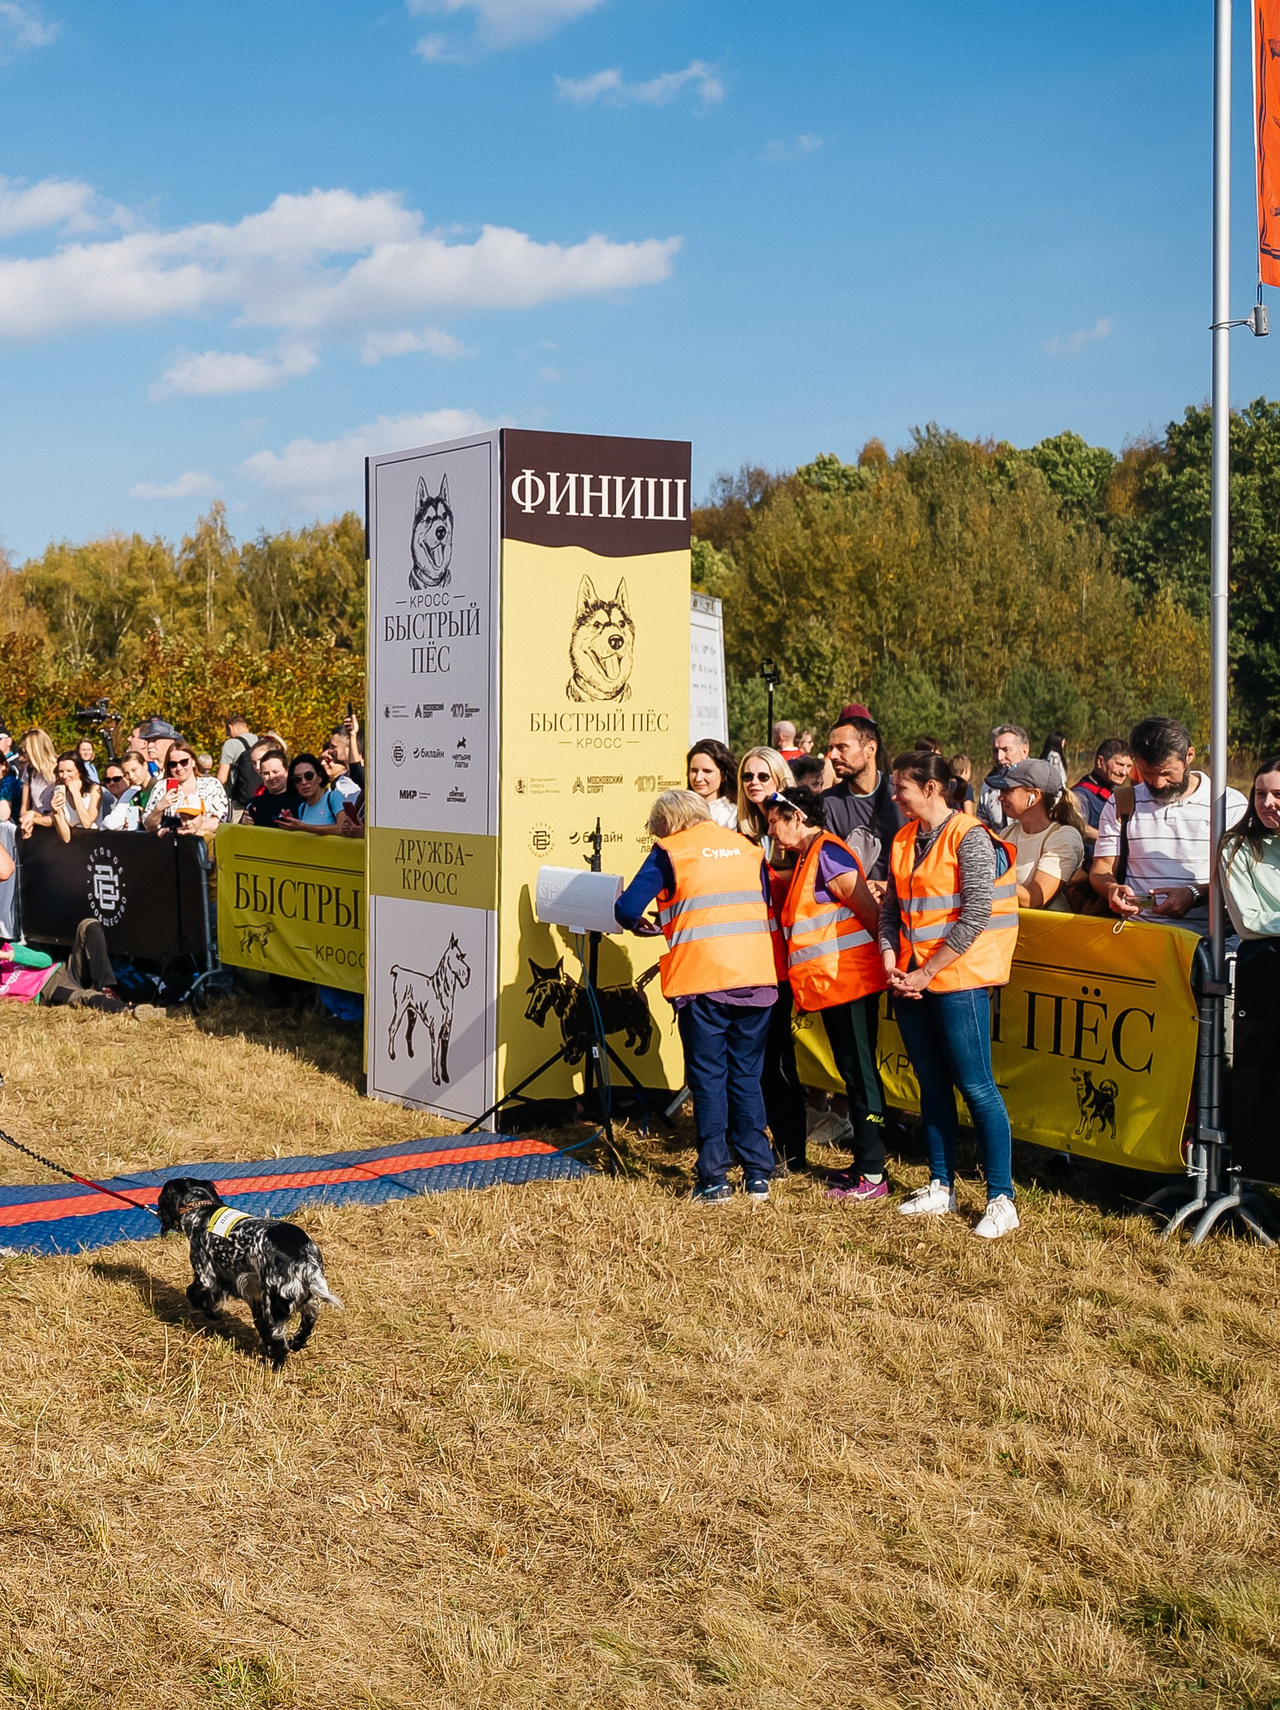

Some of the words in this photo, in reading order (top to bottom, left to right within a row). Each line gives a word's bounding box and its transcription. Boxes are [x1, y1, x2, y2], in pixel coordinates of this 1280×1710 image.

[511, 469, 687, 521] ФИНИШ
[409, 592, 450, 609] КРОСС
[384, 602, 481, 642] БЫСТРЫЙ
[410, 641, 451, 674] ПЁС
[530, 708, 625, 732] БЫСТРЫЙ
[632, 709, 669, 732] ПЁС
[421, 747, 445, 758] билайн
[577, 737, 622, 749] КРОСС
[399, 789, 417, 799] МИР
[582, 831, 623, 843] байн
[395, 838, 474, 866] ДРУЖБА-
[701, 847, 741, 860] Судья
[402, 868, 458, 895] КРОСС
[233, 871, 365, 932] БЫСТРЫ
[1022, 985, 1156, 1075] ПЁС
